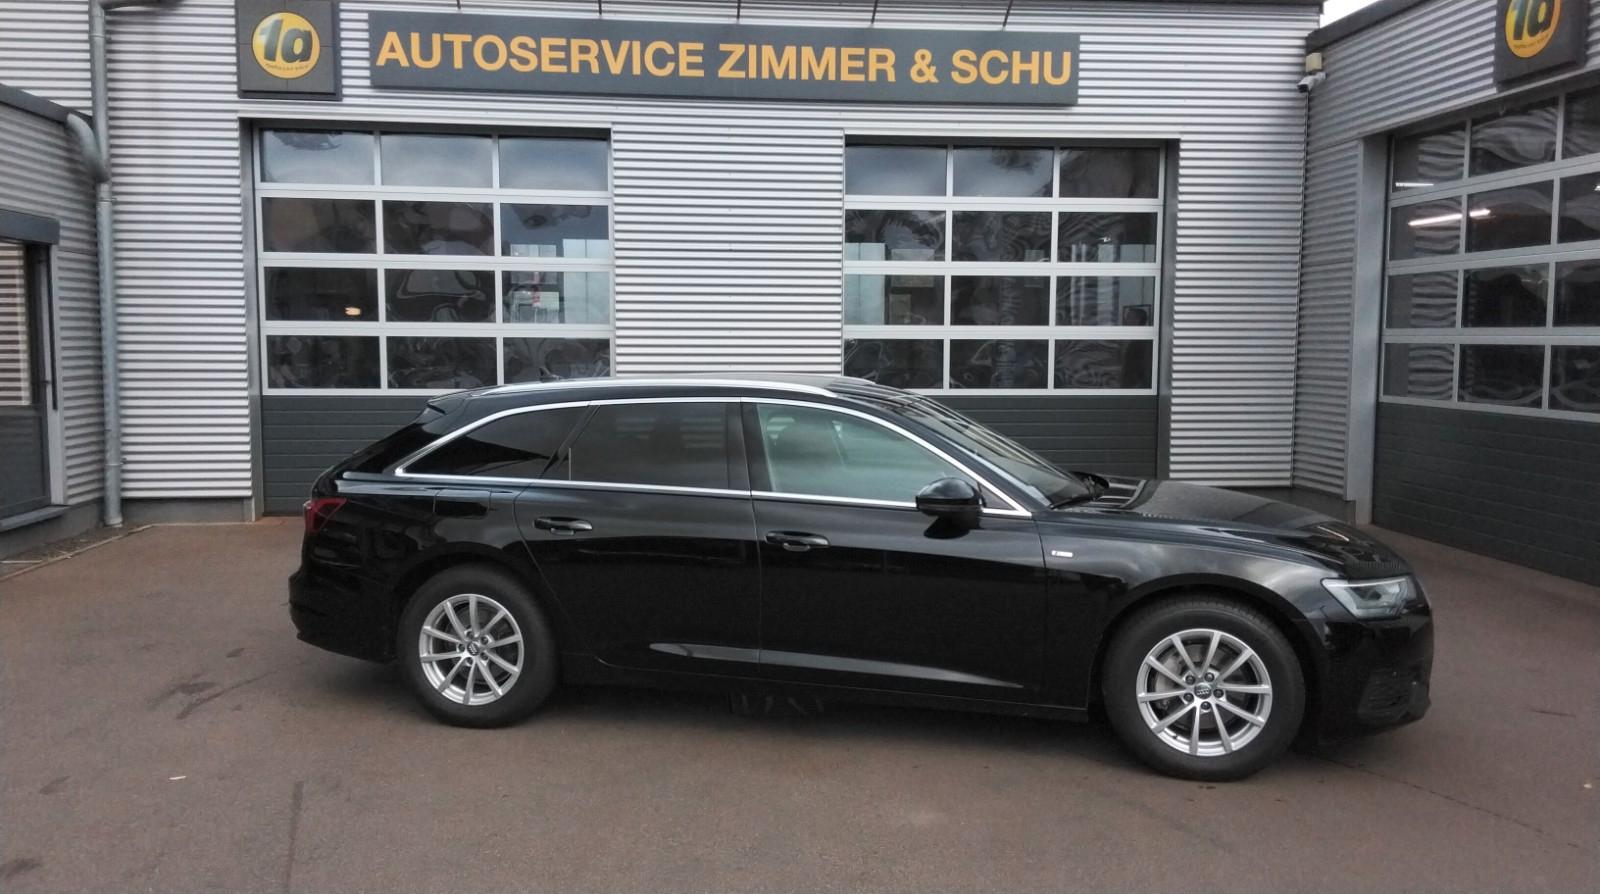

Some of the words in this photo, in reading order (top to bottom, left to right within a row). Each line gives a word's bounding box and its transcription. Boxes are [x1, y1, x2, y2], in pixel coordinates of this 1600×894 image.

[259, 19, 314, 64] 1a
[376, 31, 705, 79] AUTOSERVICE
[718, 43, 897, 83] ZIMMER
[909, 49, 937, 84] &
[951, 50, 1073, 86] SCHU
